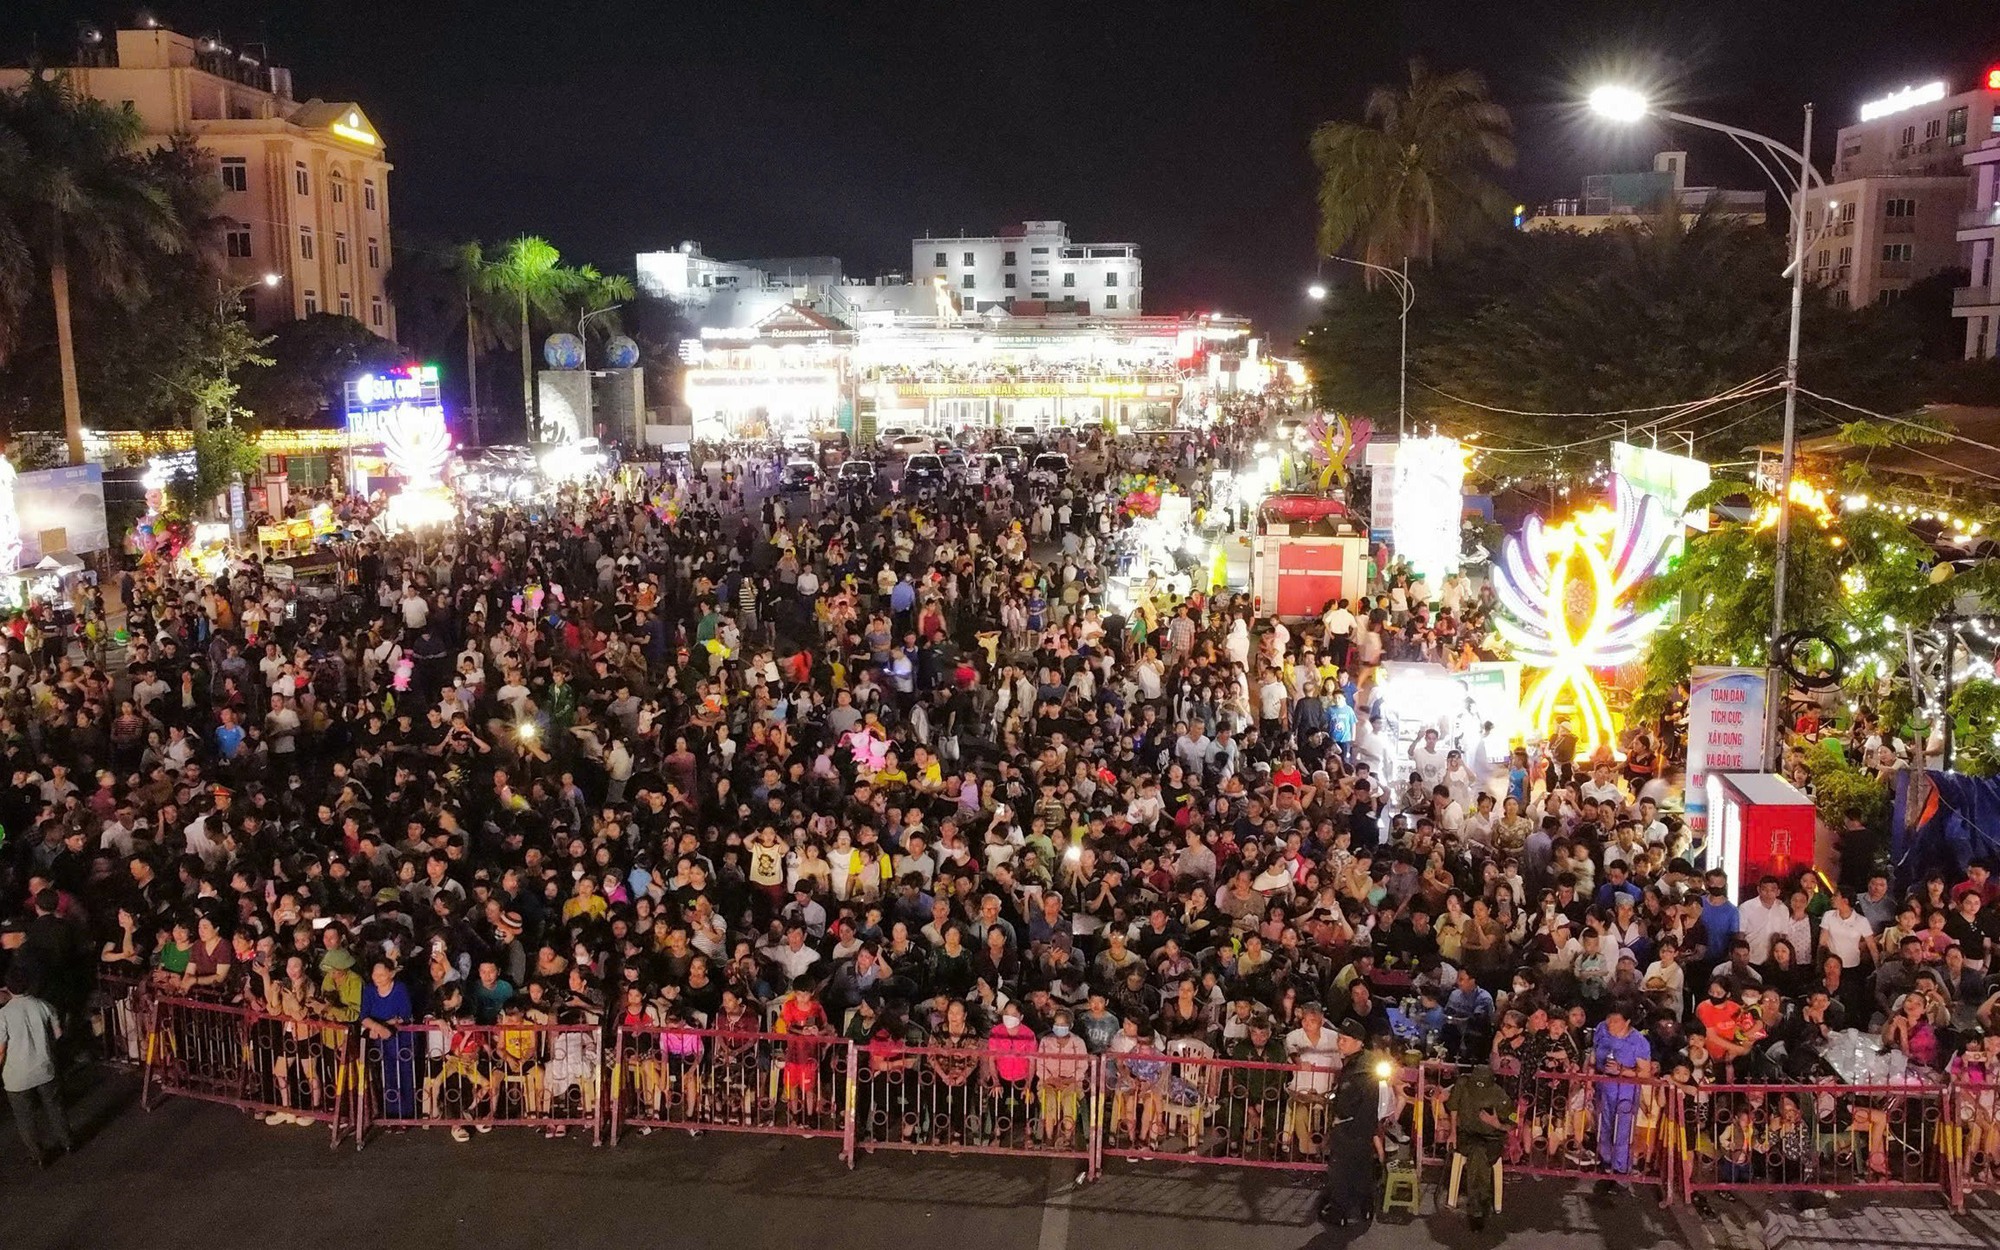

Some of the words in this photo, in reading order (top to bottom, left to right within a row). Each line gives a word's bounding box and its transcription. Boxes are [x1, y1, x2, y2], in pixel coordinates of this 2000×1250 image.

[772, 328, 829, 338] Restaurant
[1730, 687, 1745, 702] DÂN
[1711, 708, 1727, 723] TÍCH
[1708, 730, 1722, 745] XÂY
